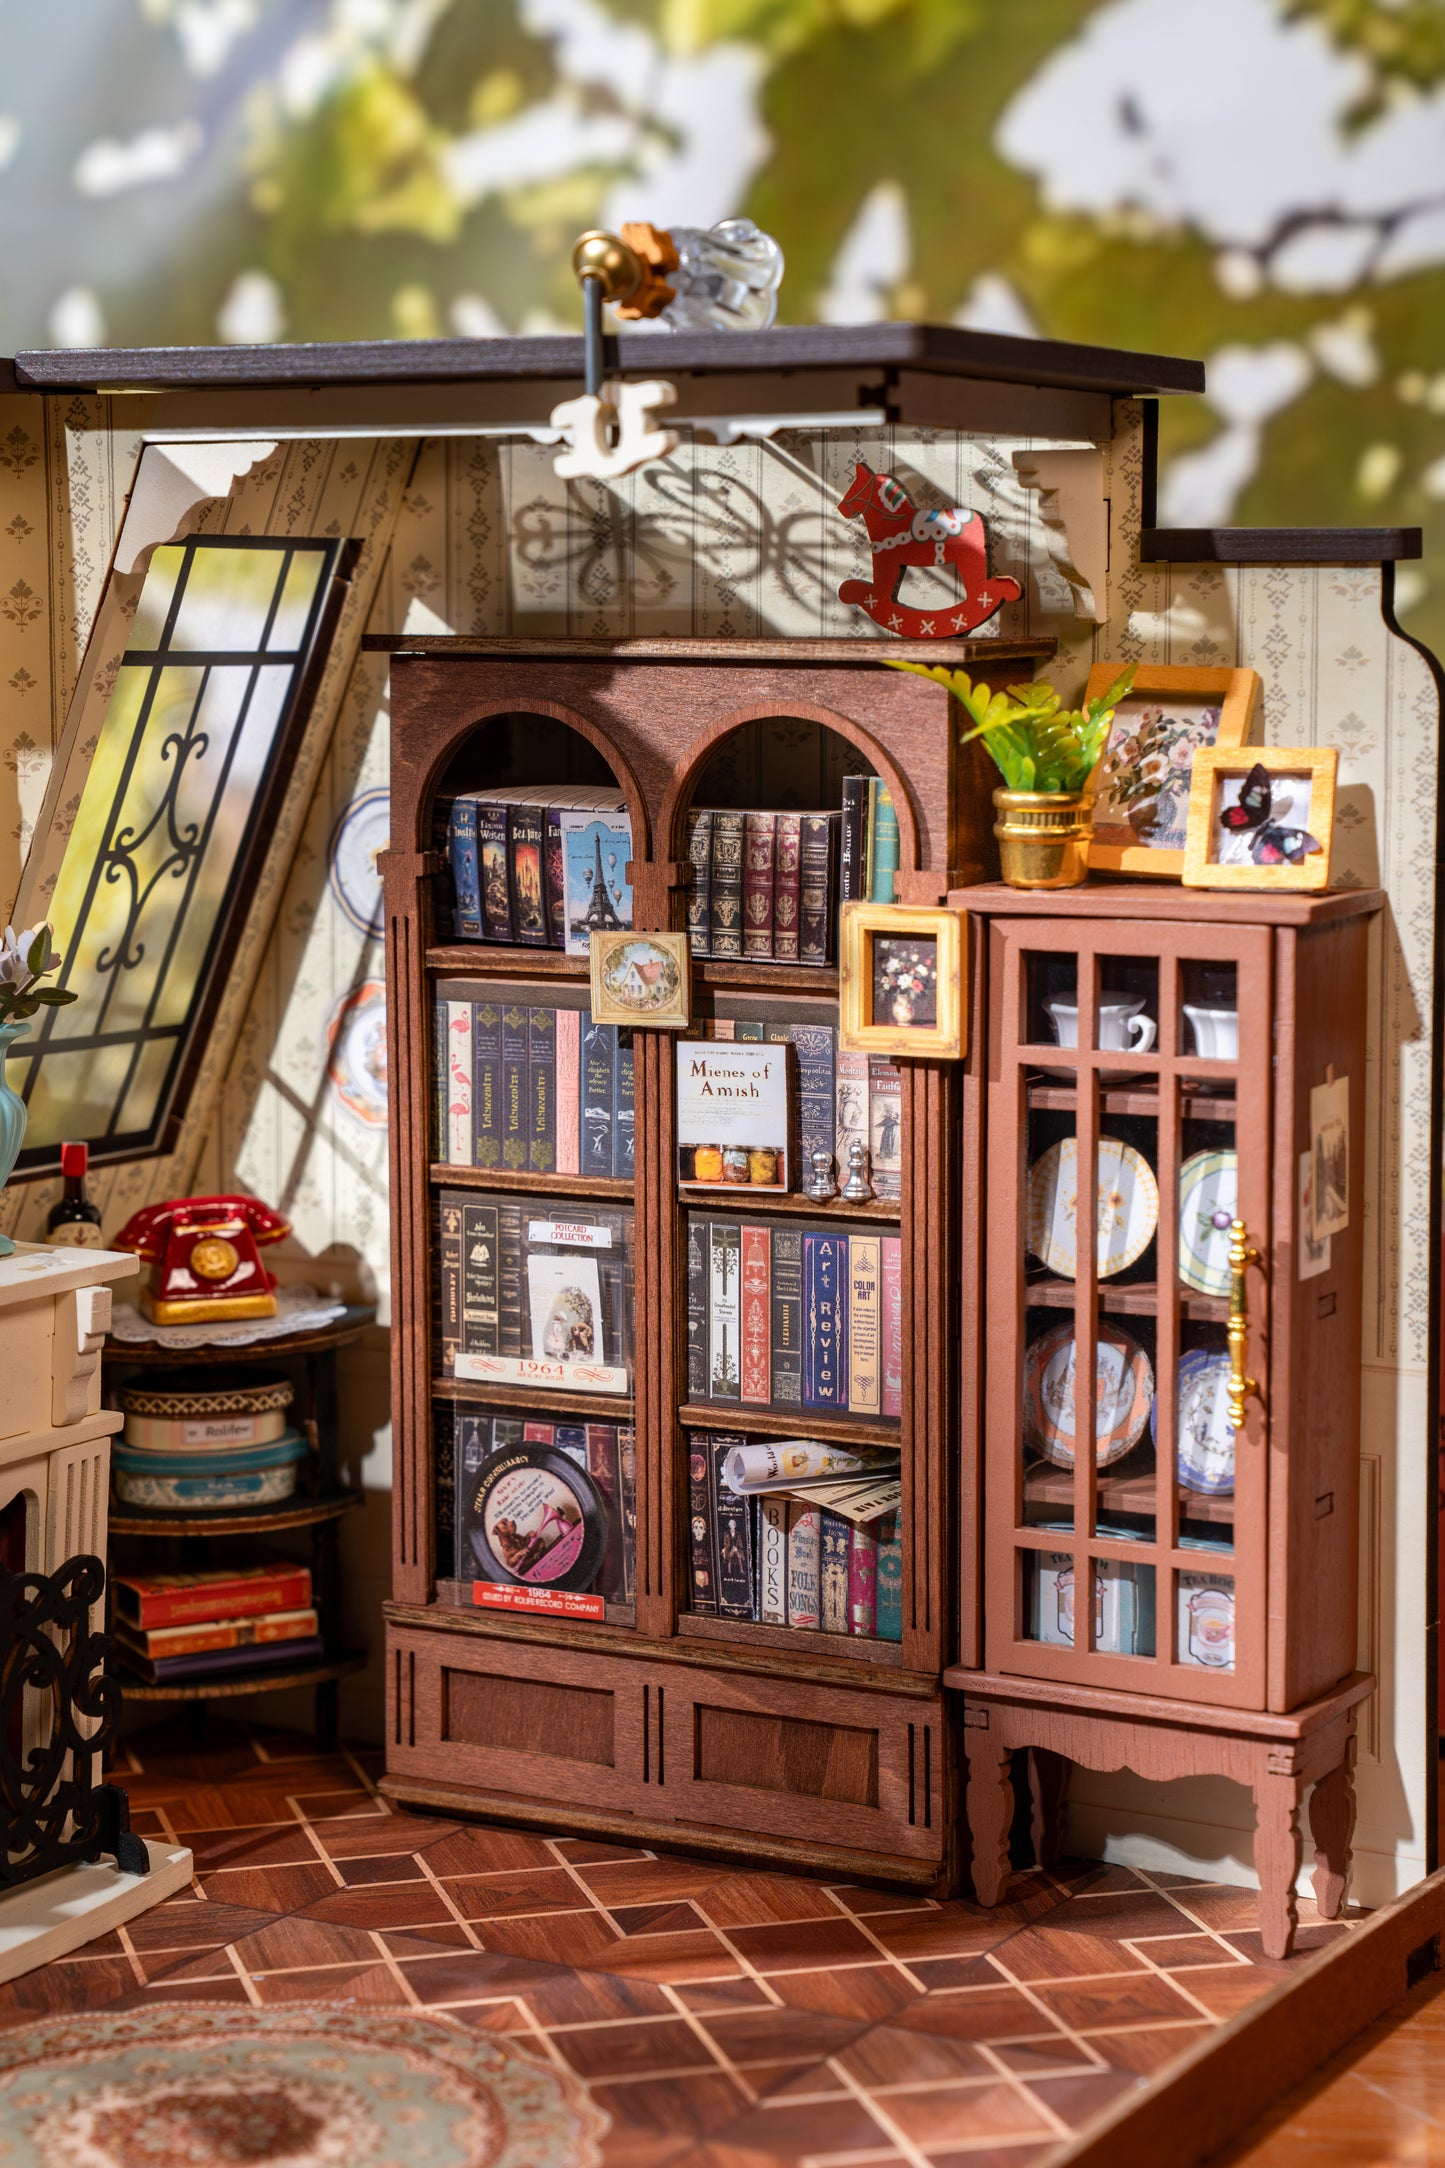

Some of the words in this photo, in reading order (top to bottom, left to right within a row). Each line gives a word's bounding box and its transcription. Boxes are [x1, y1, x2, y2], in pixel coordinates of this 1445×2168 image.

[690, 1060, 745, 1078] Mienes
[752, 1062, 772, 1080] of
[701, 1081, 759, 1098] Amish
[854, 1280, 875, 1291] COLOR
[858, 1291, 871, 1300] ART
[520, 1360, 564, 1376] 1964
[768, 1508, 779, 1606] BOOKS
[565, 1602, 600, 1613] COMPANY
